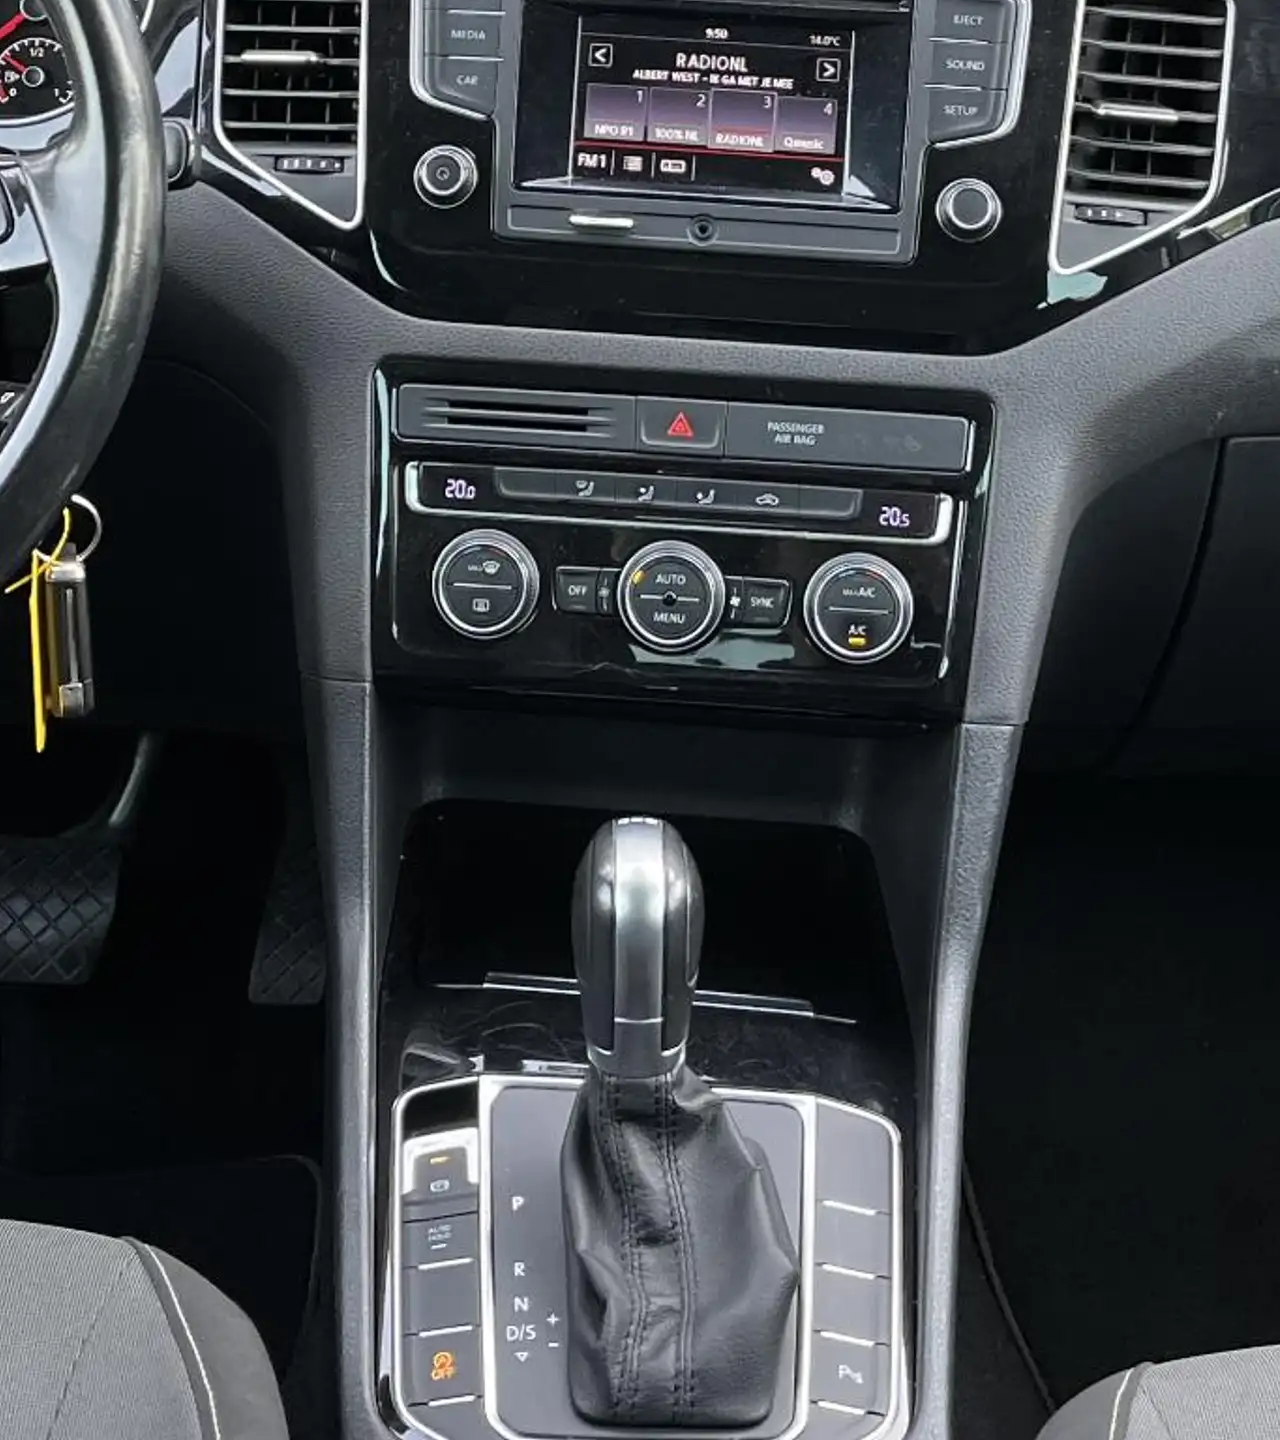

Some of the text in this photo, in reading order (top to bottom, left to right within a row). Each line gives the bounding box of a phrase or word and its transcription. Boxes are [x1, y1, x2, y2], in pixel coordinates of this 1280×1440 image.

[952, 14, 984, 26] EJECT
[450, 29, 486, 40] MEDIA
[705, 28, 728, 39] 9:50
[29, 47, 44, 58] 1/2
[675, 53, 749, 73] RADIONL
[945, 59, 986, 71] SOUND
[455, 74, 479, 86] CAR
[632, 69, 669, 80] ALBERT
[671, 71, 700, 83] WEST
[720, 75, 737, 86] GA
[9, 87, 17, 96] 0
[636, 90, 643, 103] 1
[696, 94, 706, 108] 2
[763, 96, 772, 109] 3
[823, 102, 833, 115] 4
[943, 104, 978, 116] SETUP
[594, 124, 619, 136] NPO
[715, 133, 765, 148] RADIONL
[767, 421, 825, 435] PASSENGER
[775, 433, 817, 446] AIR BAG
[655, 574, 686, 586] AUTO
[568, 585, 588, 597] OFF
[857, 586, 876, 598] A/C
[750, 596, 774, 609] SYNC
[653, 613, 686, 624] MENU
[848, 624, 867, 635] A/C
[511, 1196, 524, 1211] P
[514, 1262, 525, 1276] R
[513, 1297, 528, 1312] N
[506, 1325, 536, 1341] D/S
[431, 1369, 455, 1381] OFF
